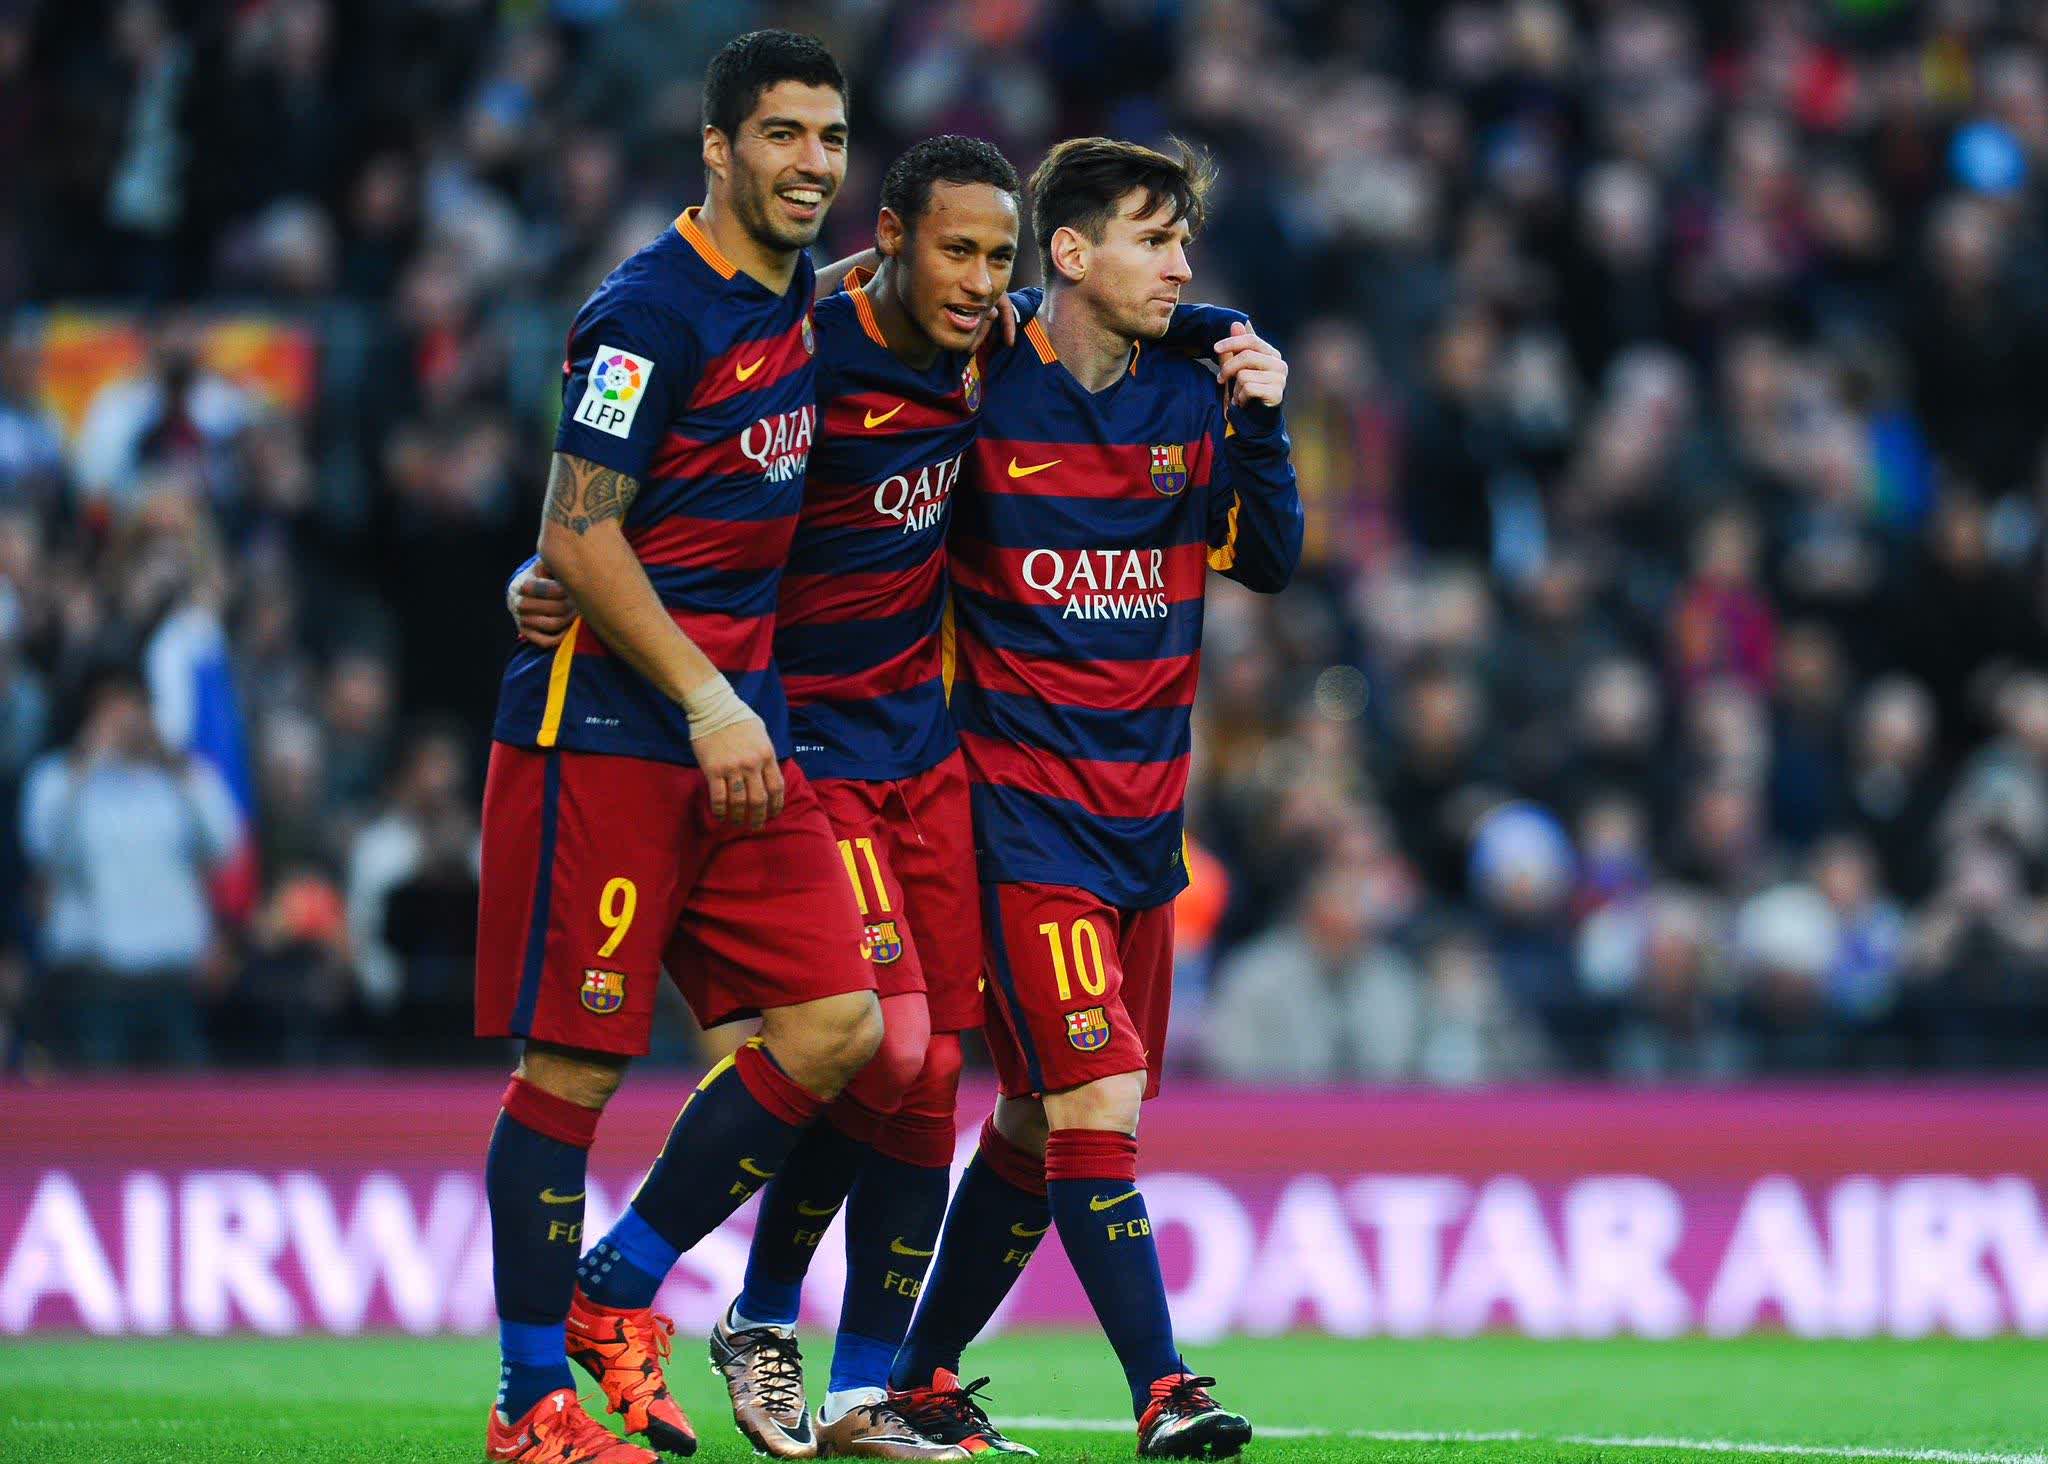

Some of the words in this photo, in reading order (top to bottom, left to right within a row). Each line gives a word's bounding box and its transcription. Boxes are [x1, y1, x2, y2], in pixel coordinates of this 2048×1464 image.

[583, 400, 626, 430] LFP
[740, 404, 816, 469] QATA
[1022, 548, 1165, 600] QATAR
[1062, 592, 1168, 620] AIRWAYS
[836, 837, 892, 915] 11
[597, 876, 638, 958] 9
[1039, 918, 1106, 1000] 10
[548, 1220, 583, 1243] FC
[1106, 1217, 1150, 1241] FCB
[1705, 1172, 2048, 1340] AIR
[884, 1270, 922, 1298] FCB
